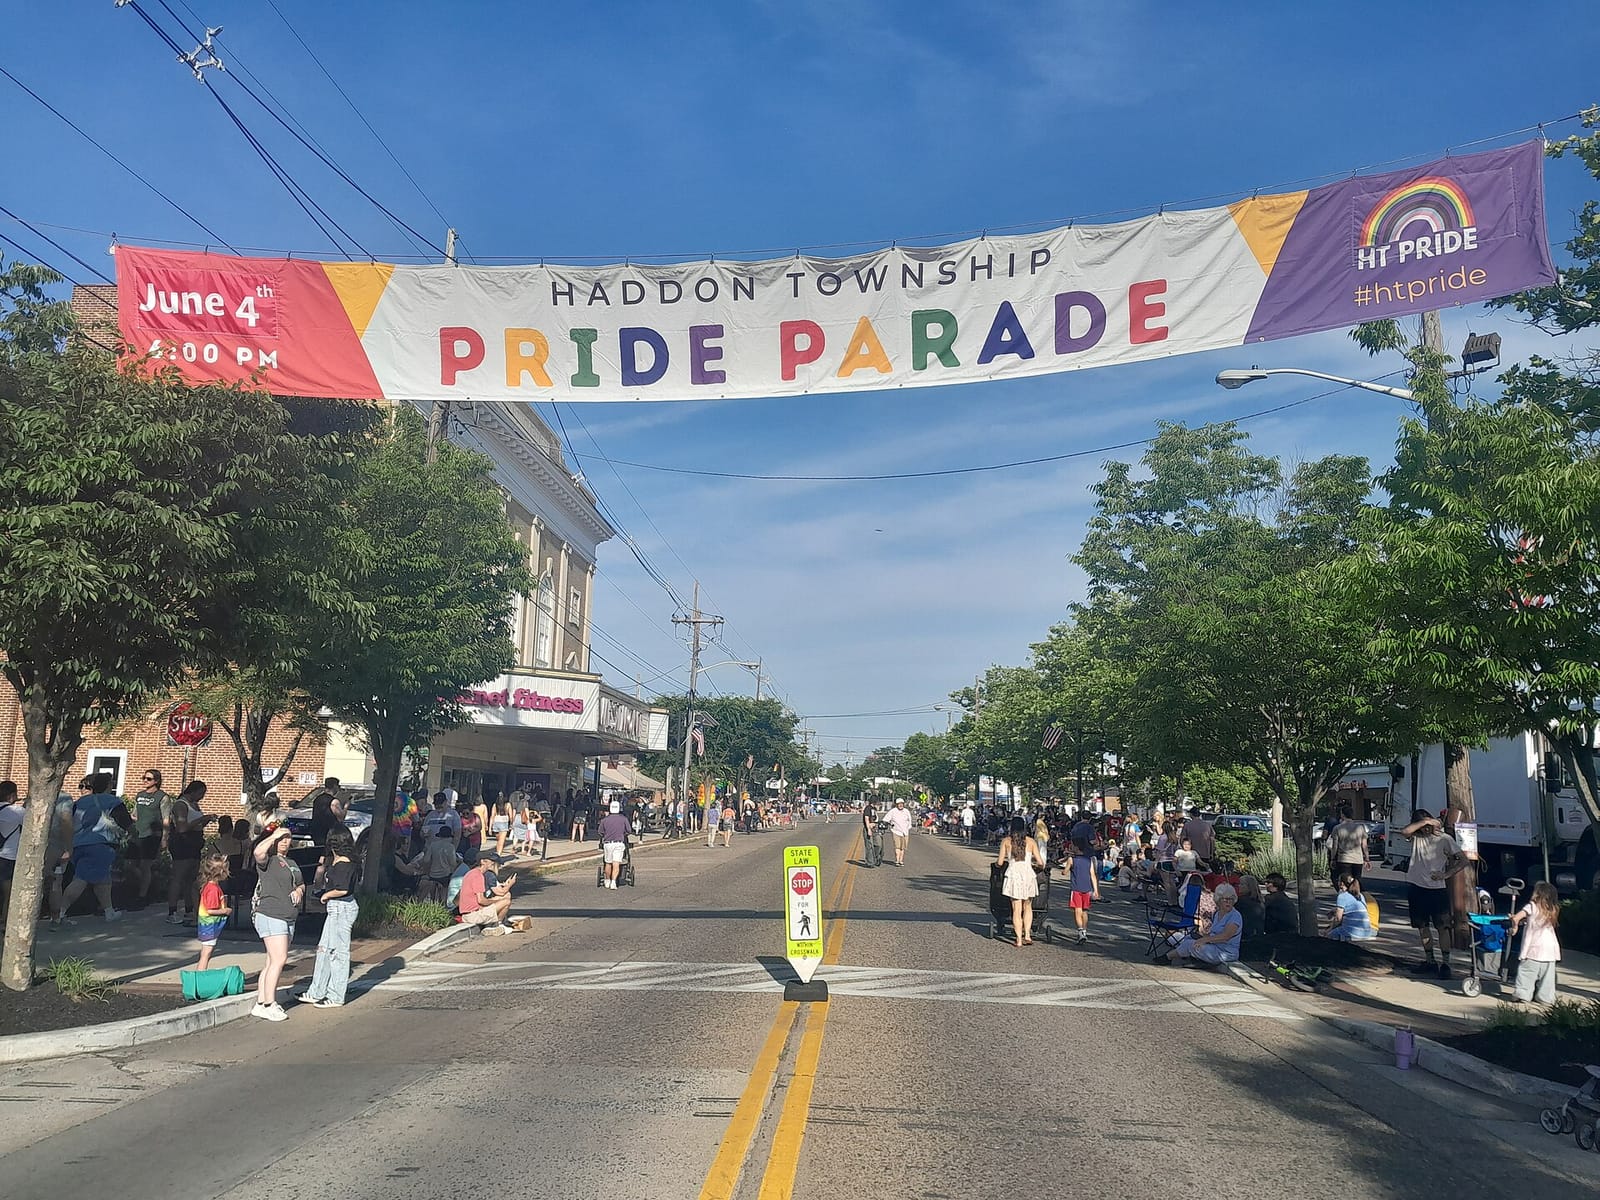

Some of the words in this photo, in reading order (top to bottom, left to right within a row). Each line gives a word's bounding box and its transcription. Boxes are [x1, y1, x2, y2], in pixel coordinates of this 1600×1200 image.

[1357, 245, 1391, 269] HT
[1398, 227, 1478, 264] PRIDE
[551, 276, 755, 306] HADDON
[786, 247, 1052, 298] TOWNSHIP
[1353, 265, 1488, 307] #htpride
[139, 282, 225, 317] June
[439, 323, 727, 388] PRIDE
[779, 278, 1170, 382] PARADE
[236, 346, 278, 369] PM
[437, 688, 510, 708] net
[512, 688, 584, 715] fitness
[790, 849, 812, 857] STATE
[792, 879, 813, 889] STOP
